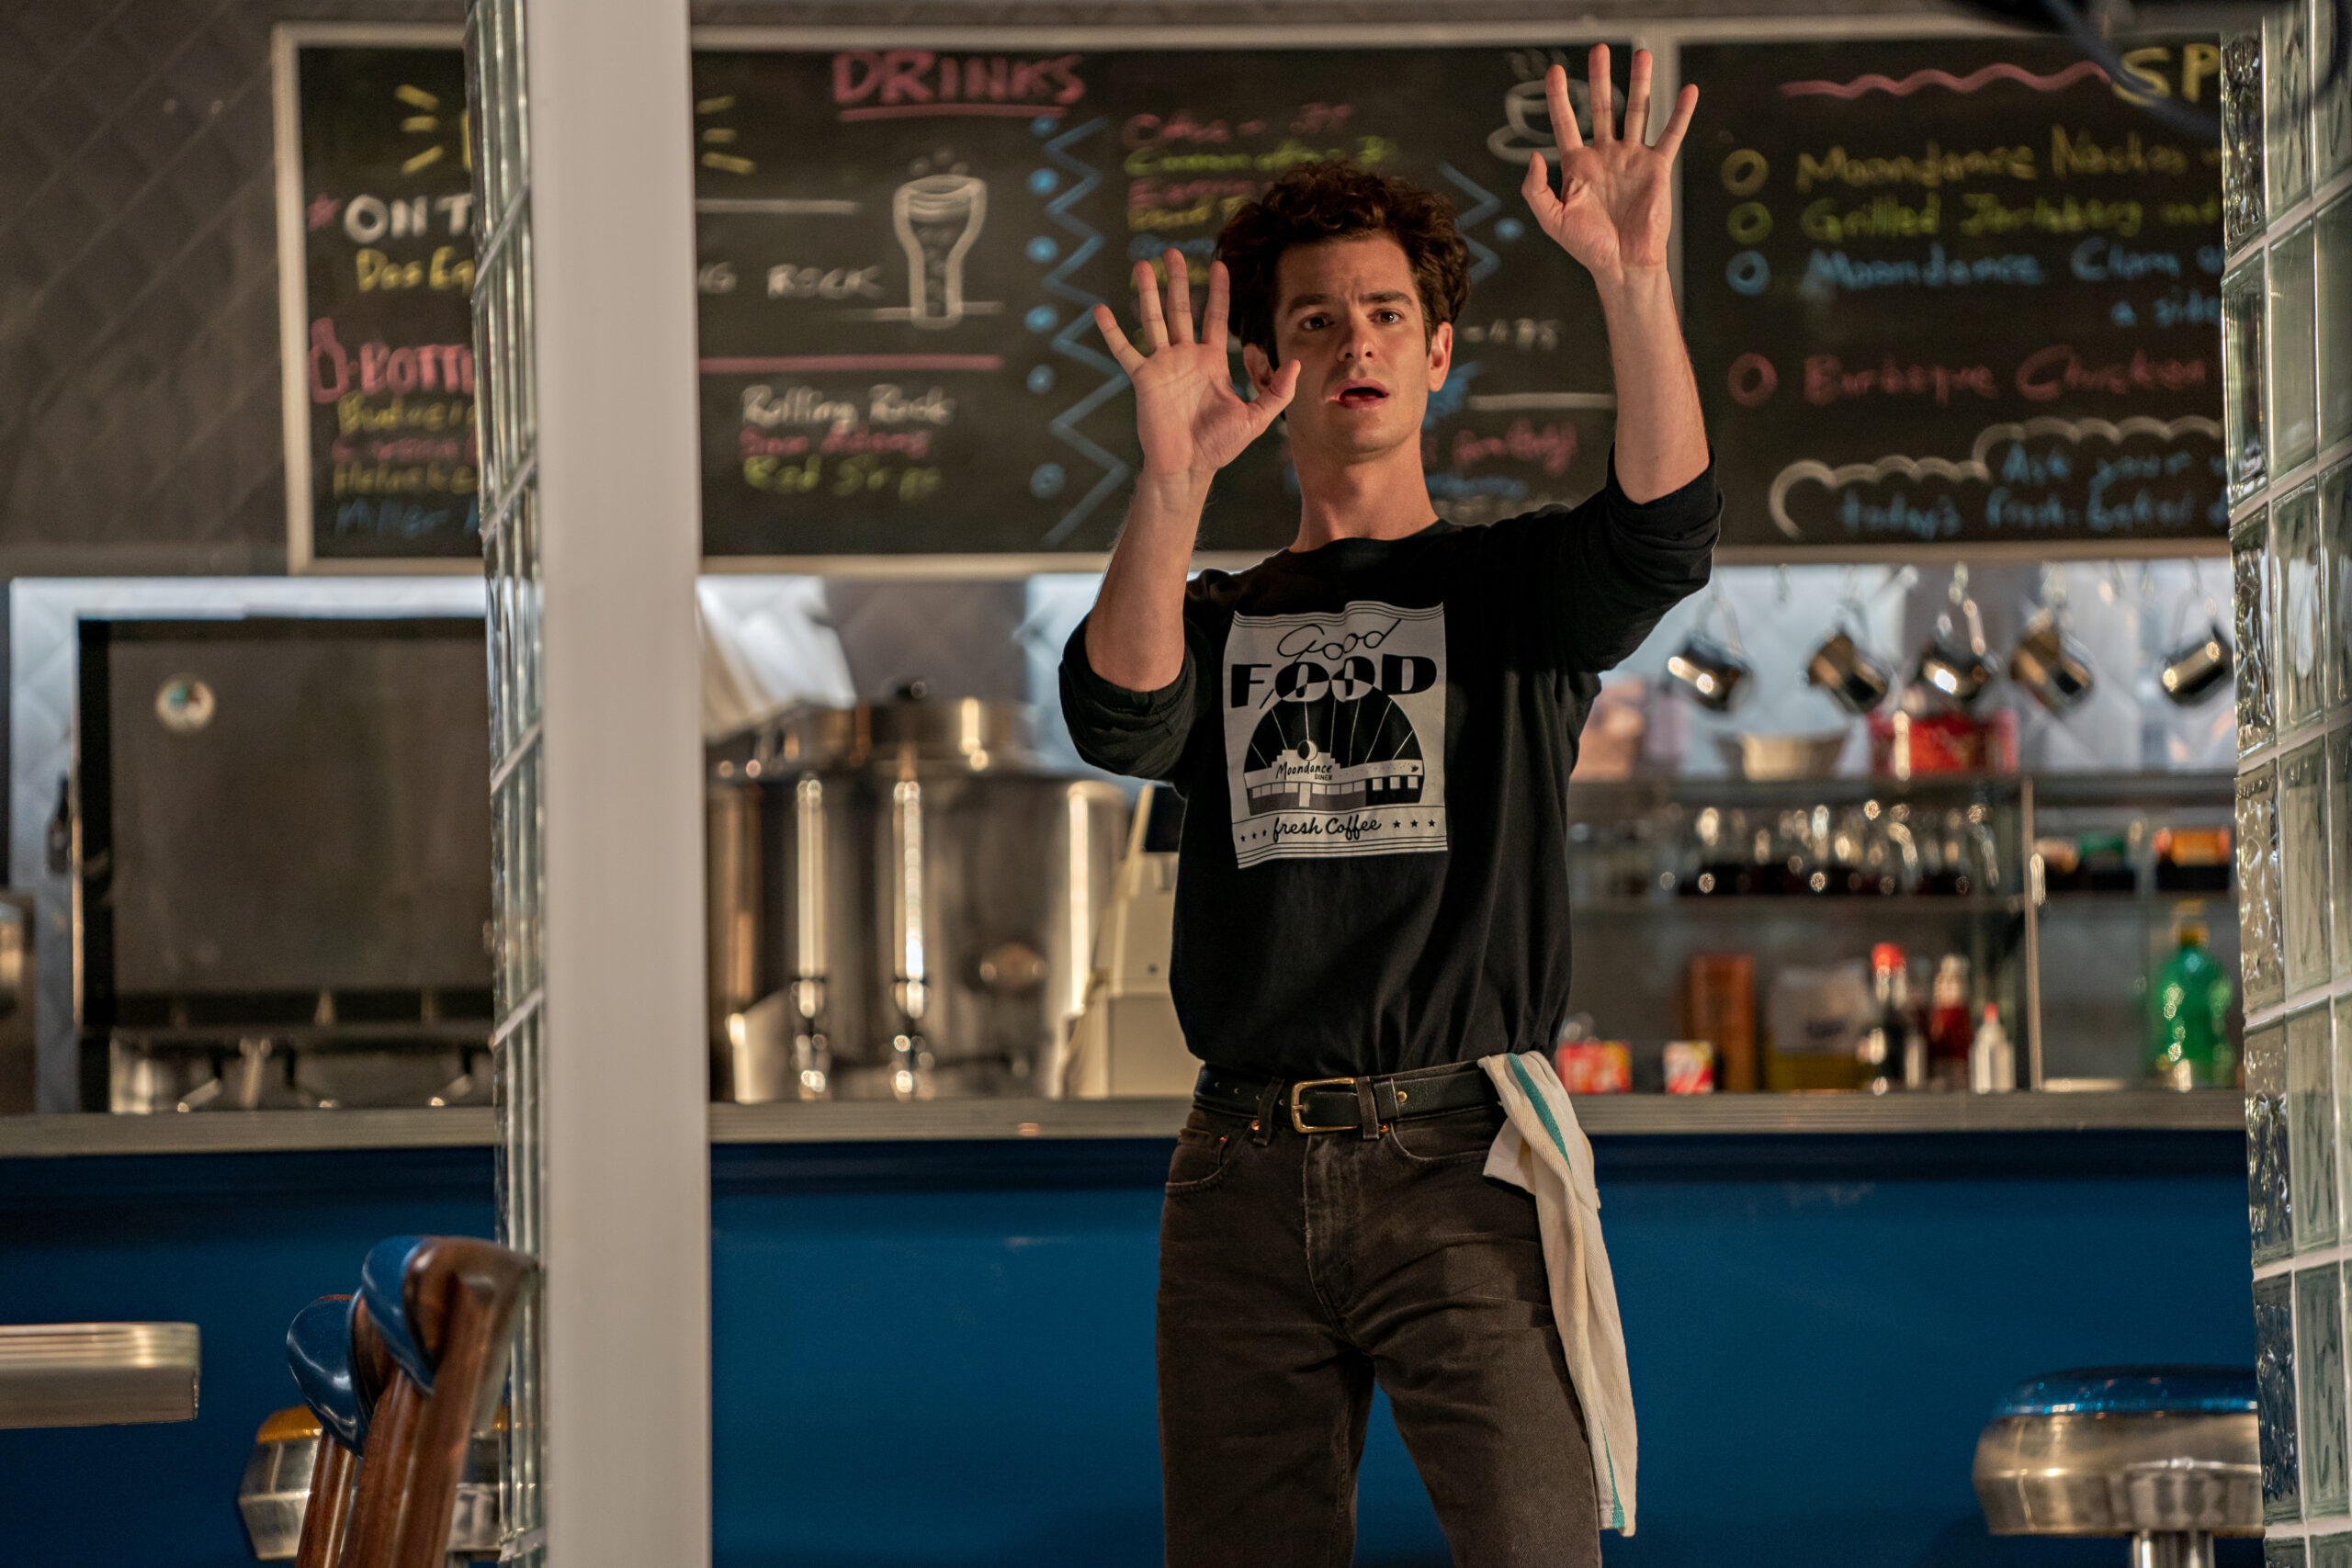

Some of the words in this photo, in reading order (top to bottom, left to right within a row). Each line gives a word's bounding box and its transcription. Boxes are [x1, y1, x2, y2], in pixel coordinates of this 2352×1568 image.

[831, 49, 1085, 104] DRINKS
[435, 191, 475, 236] T
[1277, 618, 1401, 663] Good
[1230, 654, 1437, 709] FOOD
[1275, 761, 1332, 780] Moondance
[1272, 817, 1323, 842] fresh
[1325, 816, 1382, 841] Coffee
